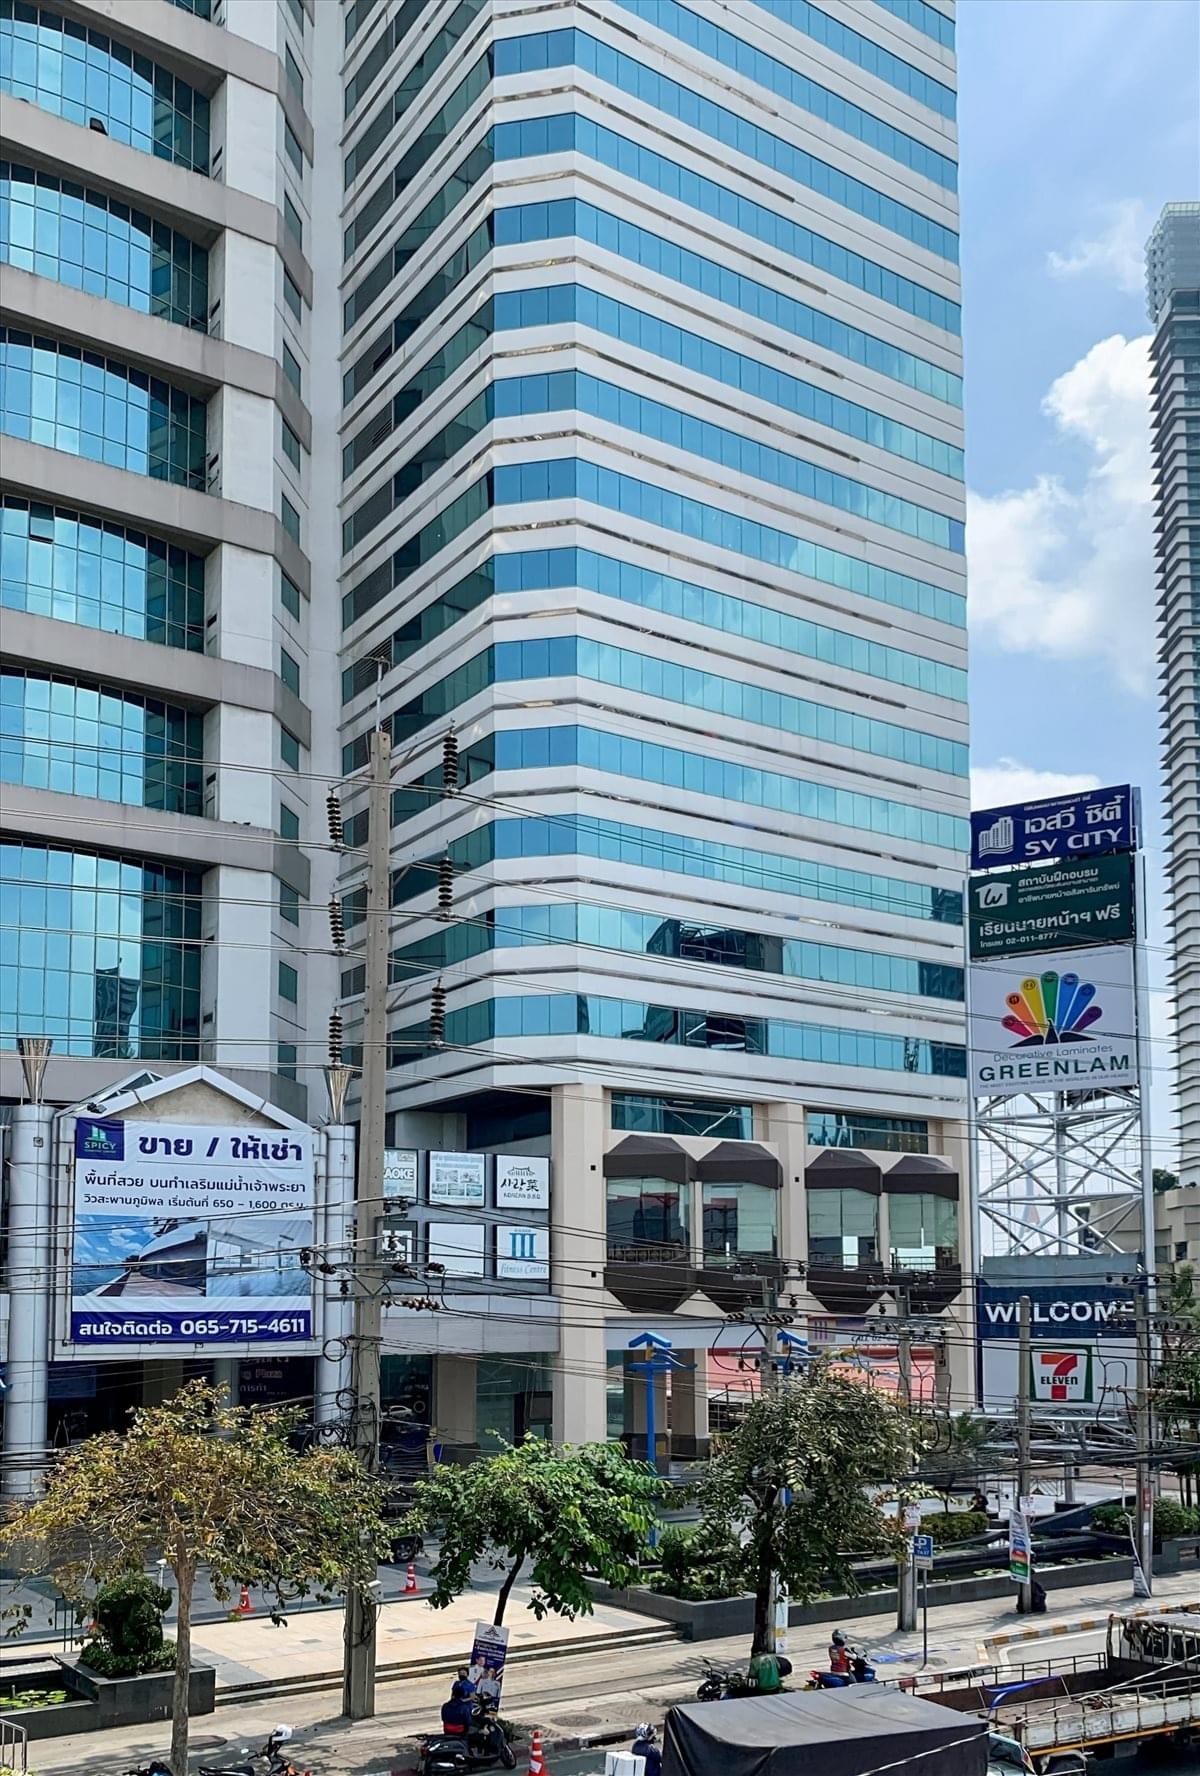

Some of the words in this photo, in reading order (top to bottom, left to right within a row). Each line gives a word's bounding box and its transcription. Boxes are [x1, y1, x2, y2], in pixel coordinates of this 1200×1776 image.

[1024, 807, 1076, 834] เอสวี
[1085, 795, 1126, 825] ซิตี้
[1025, 838, 1058, 856] SV
[1067, 827, 1123, 849] CITY
[1018, 868, 1099, 887] สถาบันฝึกอบรม
[979, 910, 1091, 937] เรียนนายหน้าฯ
[1095, 903, 1121, 921] ฟรี
[993, 1049, 1053, 1063] Decorative
[1056, 1044, 1113, 1057] Laminates
[979, 1054, 1129, 1082] GREENLAM
[84, 1141, 116, 1150] SPICY
[139, 1136, 193, 1157] ขาย
[206, 1137, 220, 1158] /
[231, 1134, 303, 1161] ให้เช่า
[85, 1170, 144, 1187] พื้นที่สวย
[150, 1176, 306, 1193] บนทำเลริมแม่น้ำเจ้าพระยา
[384, 1167, 414, 1180] AOKE
[84, 1194, 164, 1208] วิวสะพานภูมิพล
[213, 1199, 233, 1208] 650
[79, 1321, 172, 1336] สนใจติดต่อ
[180, 1318, 305, 1335] 065-715-4611
[1041, 1354, 1078, 1400] 7
